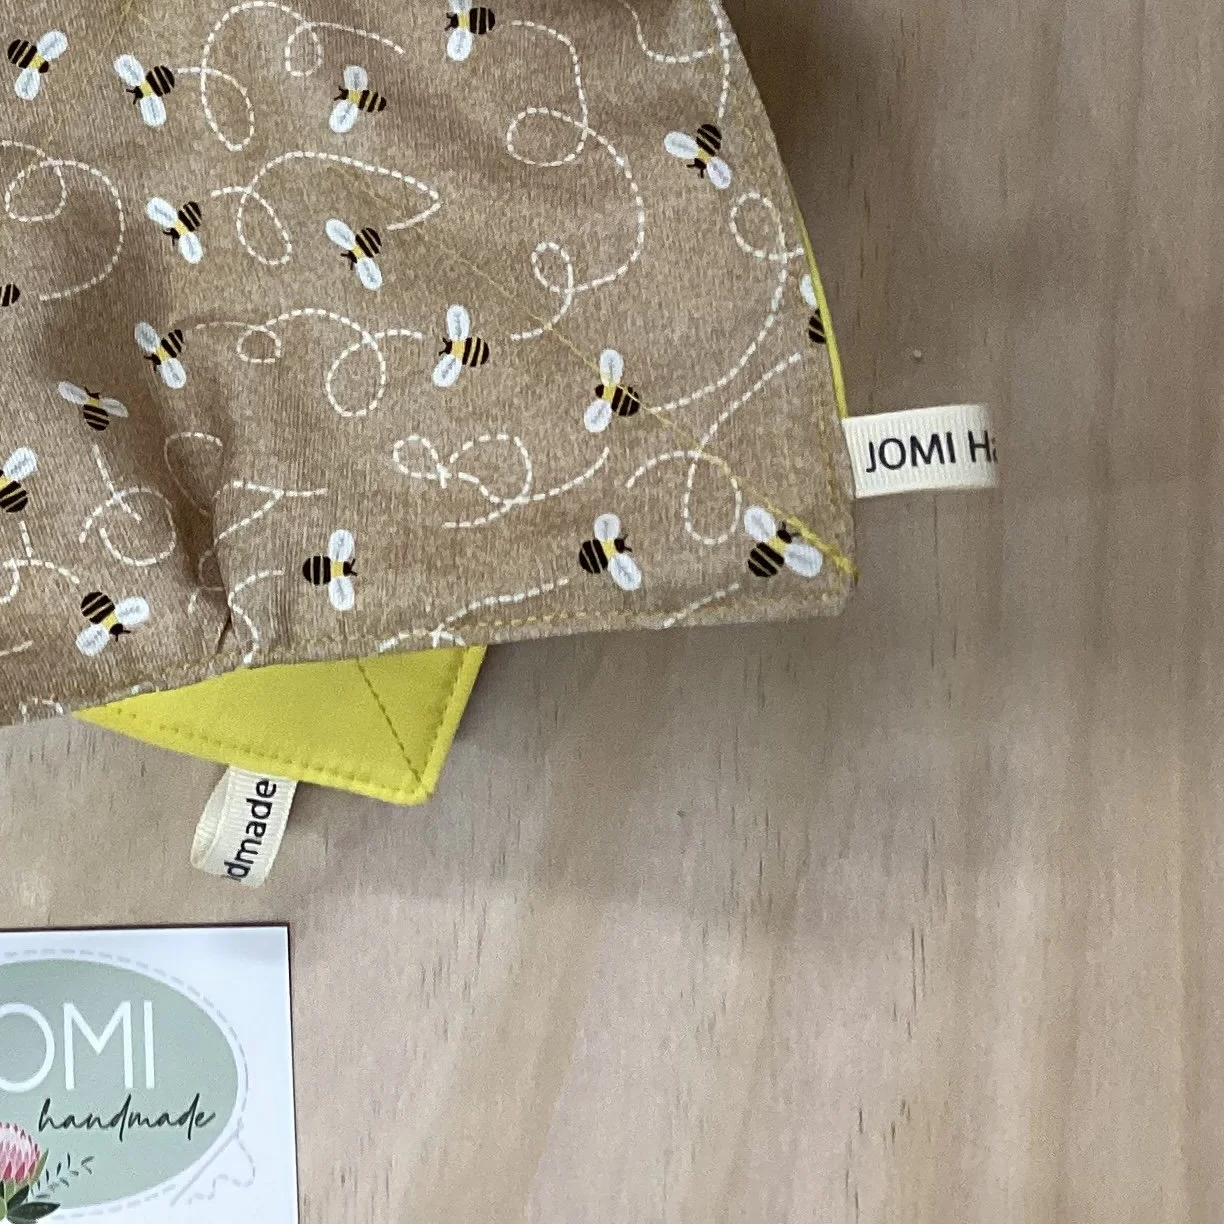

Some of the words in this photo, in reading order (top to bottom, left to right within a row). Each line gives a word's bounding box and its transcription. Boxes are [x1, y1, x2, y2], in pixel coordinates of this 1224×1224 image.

[865, 431, 956, 474] JOMI
[223, 778, 277, 882] dmade
[38, 1093, 217, 1142] handmade
